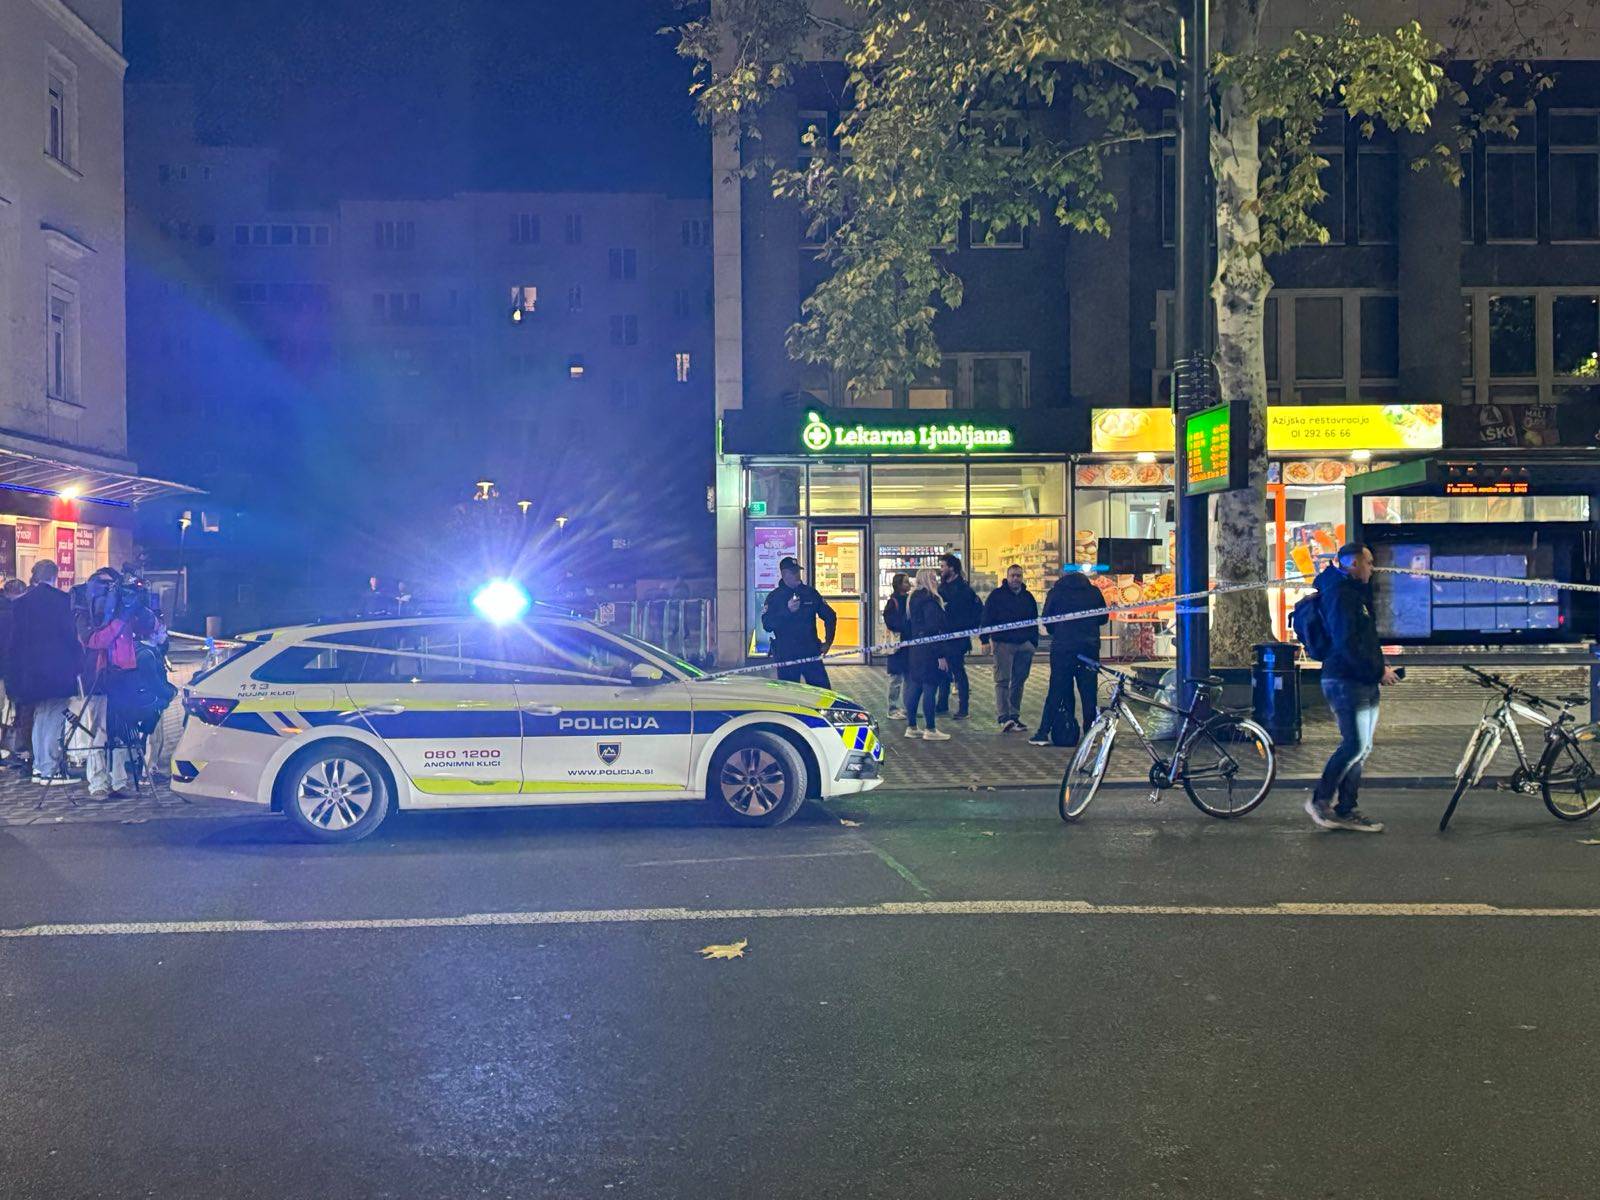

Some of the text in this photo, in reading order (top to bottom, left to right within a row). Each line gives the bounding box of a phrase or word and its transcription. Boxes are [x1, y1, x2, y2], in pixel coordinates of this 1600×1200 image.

[1272, 416, 1370, 426] Azijska restavracija
[834, 424, 1012, 449] Lekarna Ljubljana
[1291, 428, 1351, 438] 01 292 66 66
[559, 716, 660, 730] POLICIJA
[424, 749, 501, 759] 080 1200
[423, 760, 475, 768] ANONIMNI
[567, 768, 654, 776] WWW.POLICIJA.SI
